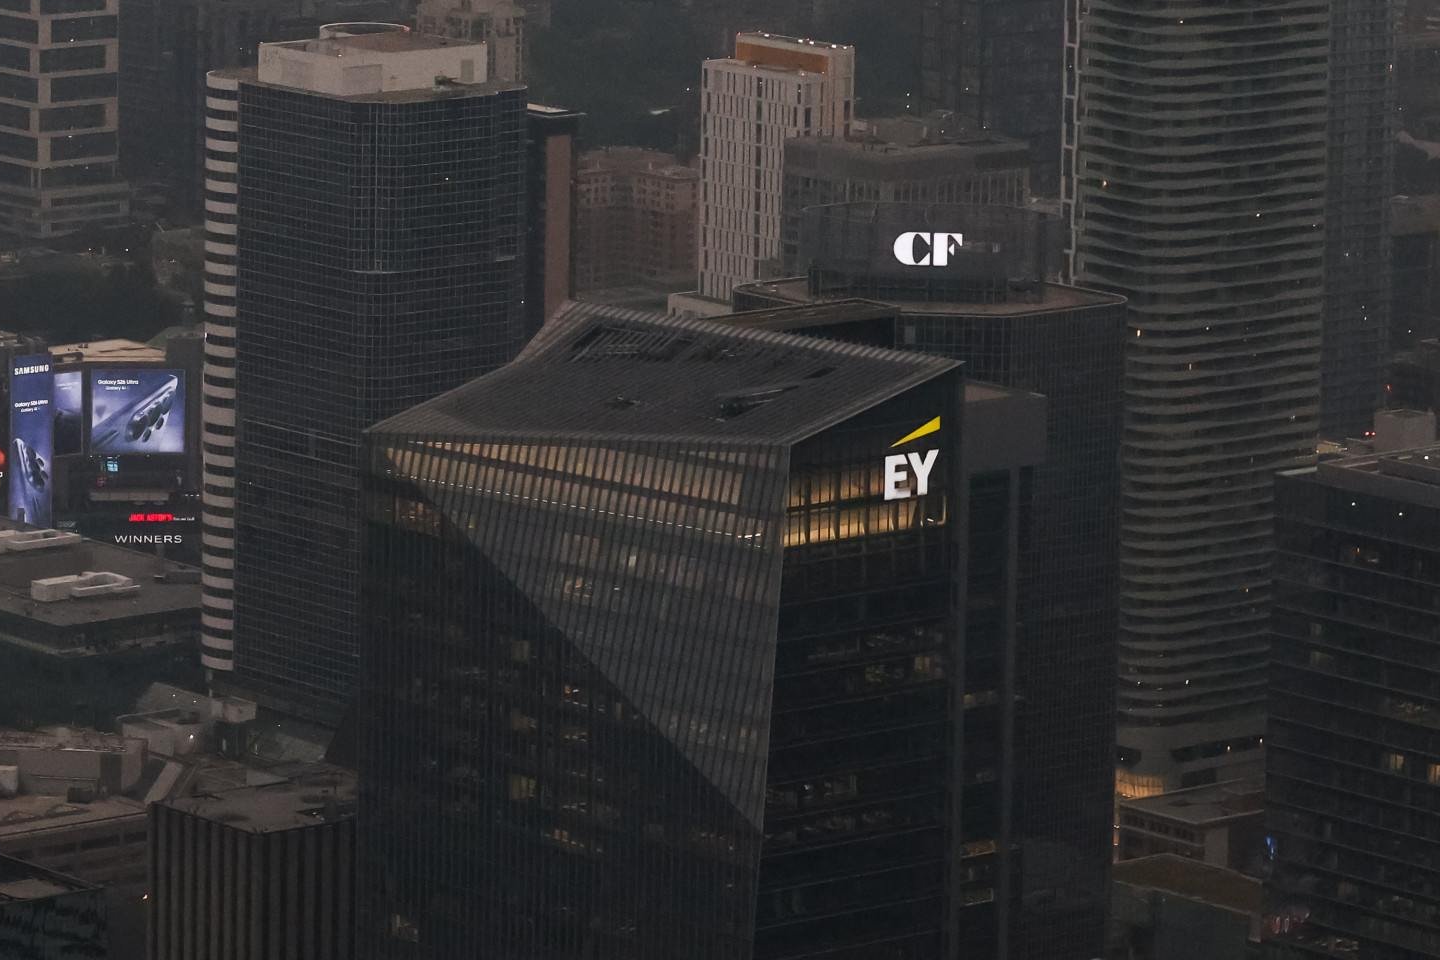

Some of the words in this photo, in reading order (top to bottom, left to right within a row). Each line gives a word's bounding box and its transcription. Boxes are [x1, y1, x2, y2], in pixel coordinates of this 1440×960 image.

[893, 231, 963, 266] CF
[14, 364, 49, 376] SAMSUNG
[884, 449, 940, 501] EY
[114, 534, 183, 544] WINNERS
